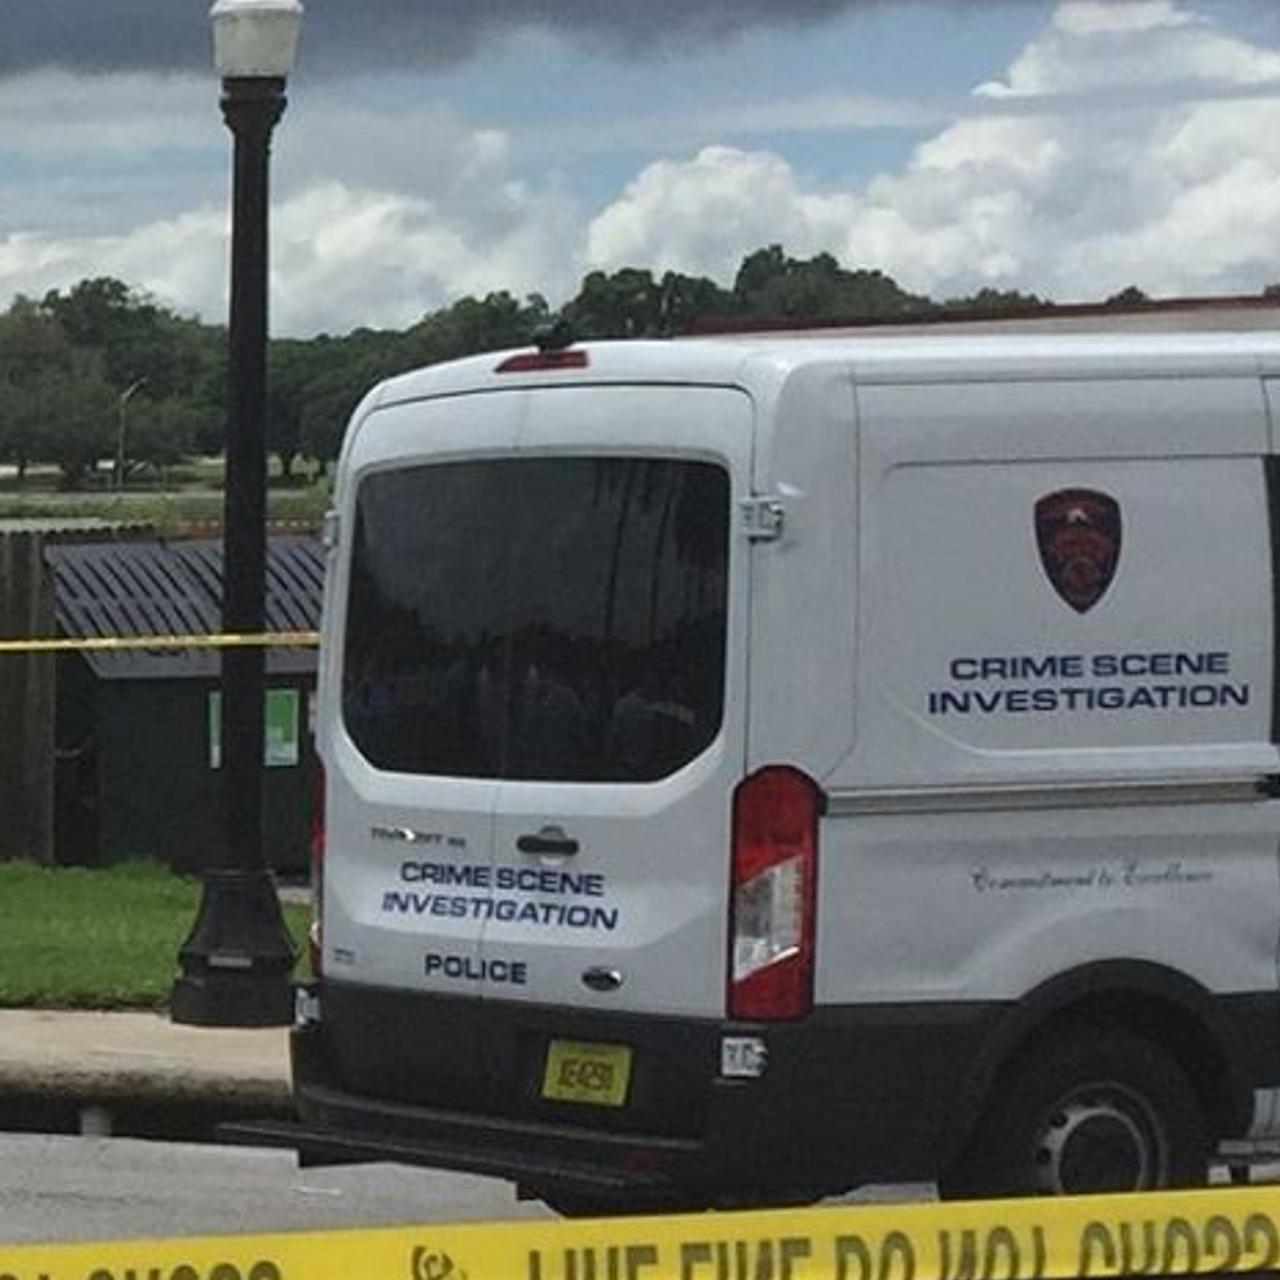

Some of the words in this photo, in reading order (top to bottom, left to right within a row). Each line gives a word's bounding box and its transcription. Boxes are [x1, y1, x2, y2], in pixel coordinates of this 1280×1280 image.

[949, 655, 1083, 681] CRIME
[1091, 651, 1231, 677] SCENE
[927, 684, 1250, 716] INVESTIGATION
[400, 861, 491, 889] CRIME
[495, 867, 606, 897] SCENE
[382, 891, 619, 931] INVESTIGATION
[424, 953, 528, 985] POLICE
